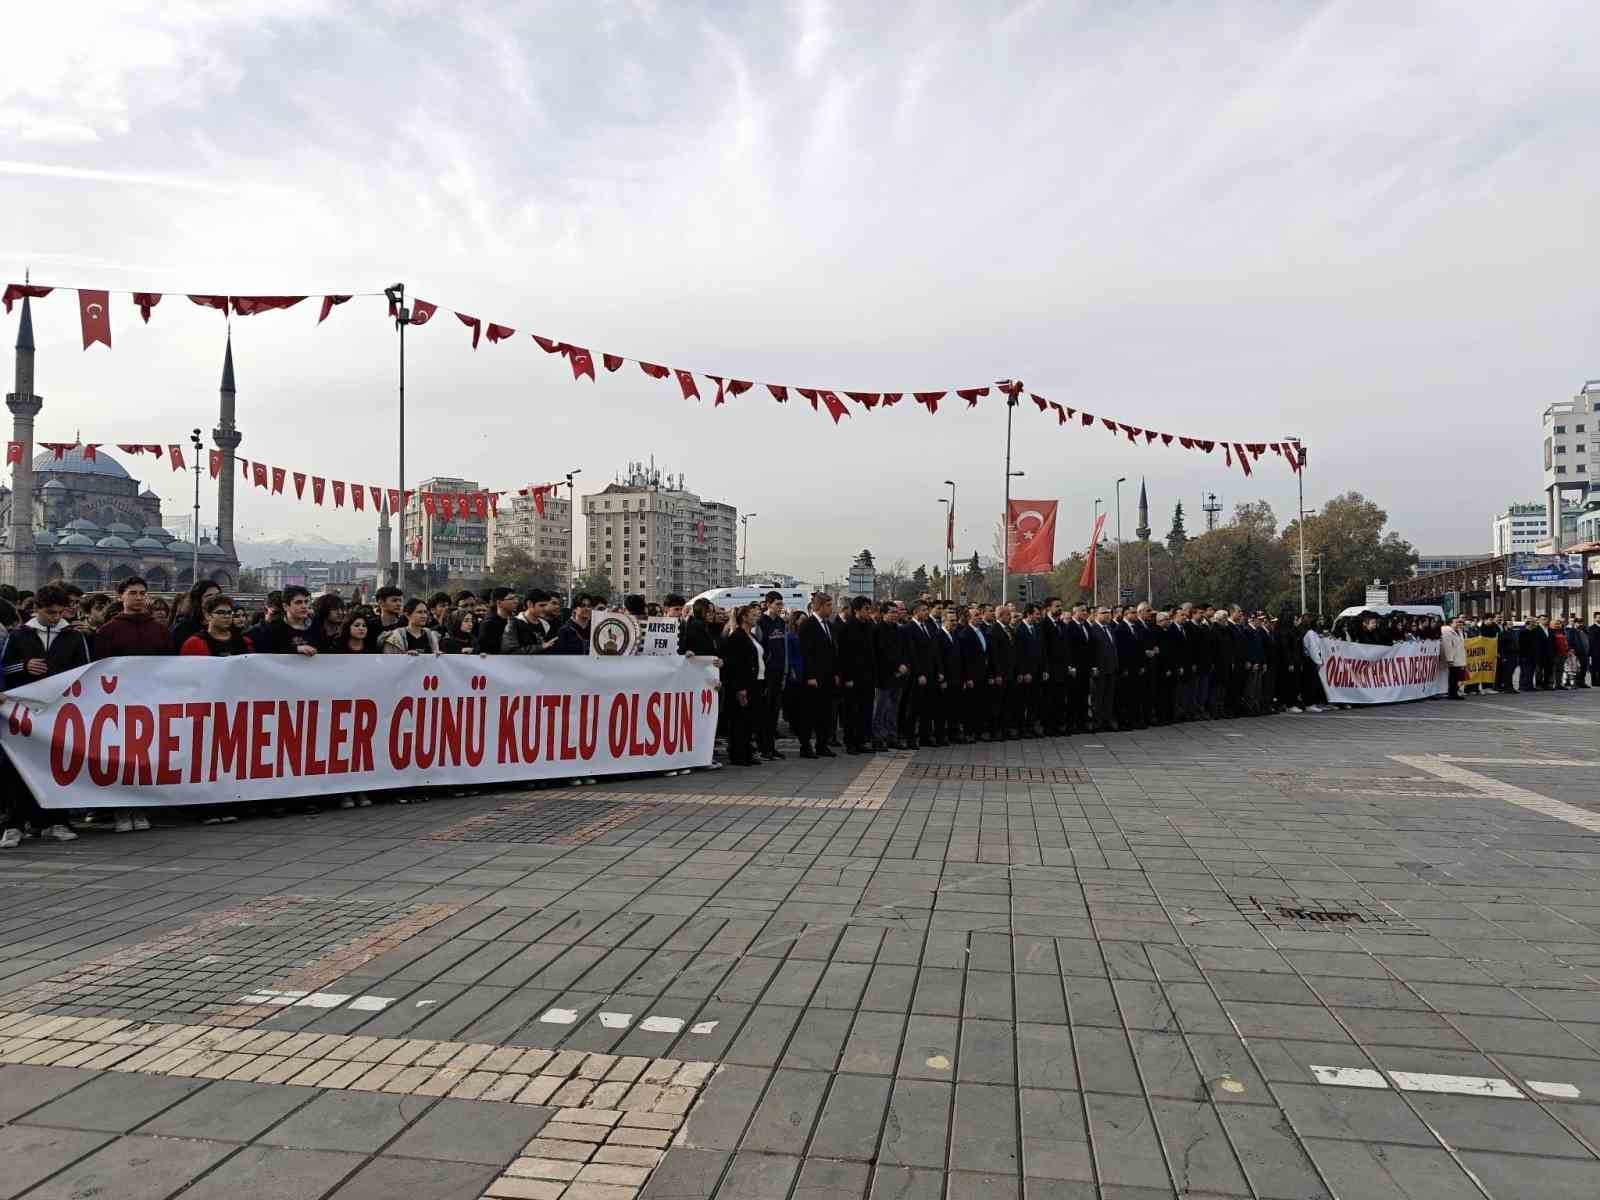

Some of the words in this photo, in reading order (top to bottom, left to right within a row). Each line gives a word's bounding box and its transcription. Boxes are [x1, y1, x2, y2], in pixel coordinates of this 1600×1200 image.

[654, 638, 668, 649] FEN
[51, 676, 377, 786] ÖĞRETMENLER
[389, 675, 487, 770] GÜNÜ
[497, 694, 600, 764] KUTLU
[608, 692, 694, 758] OLSUN
